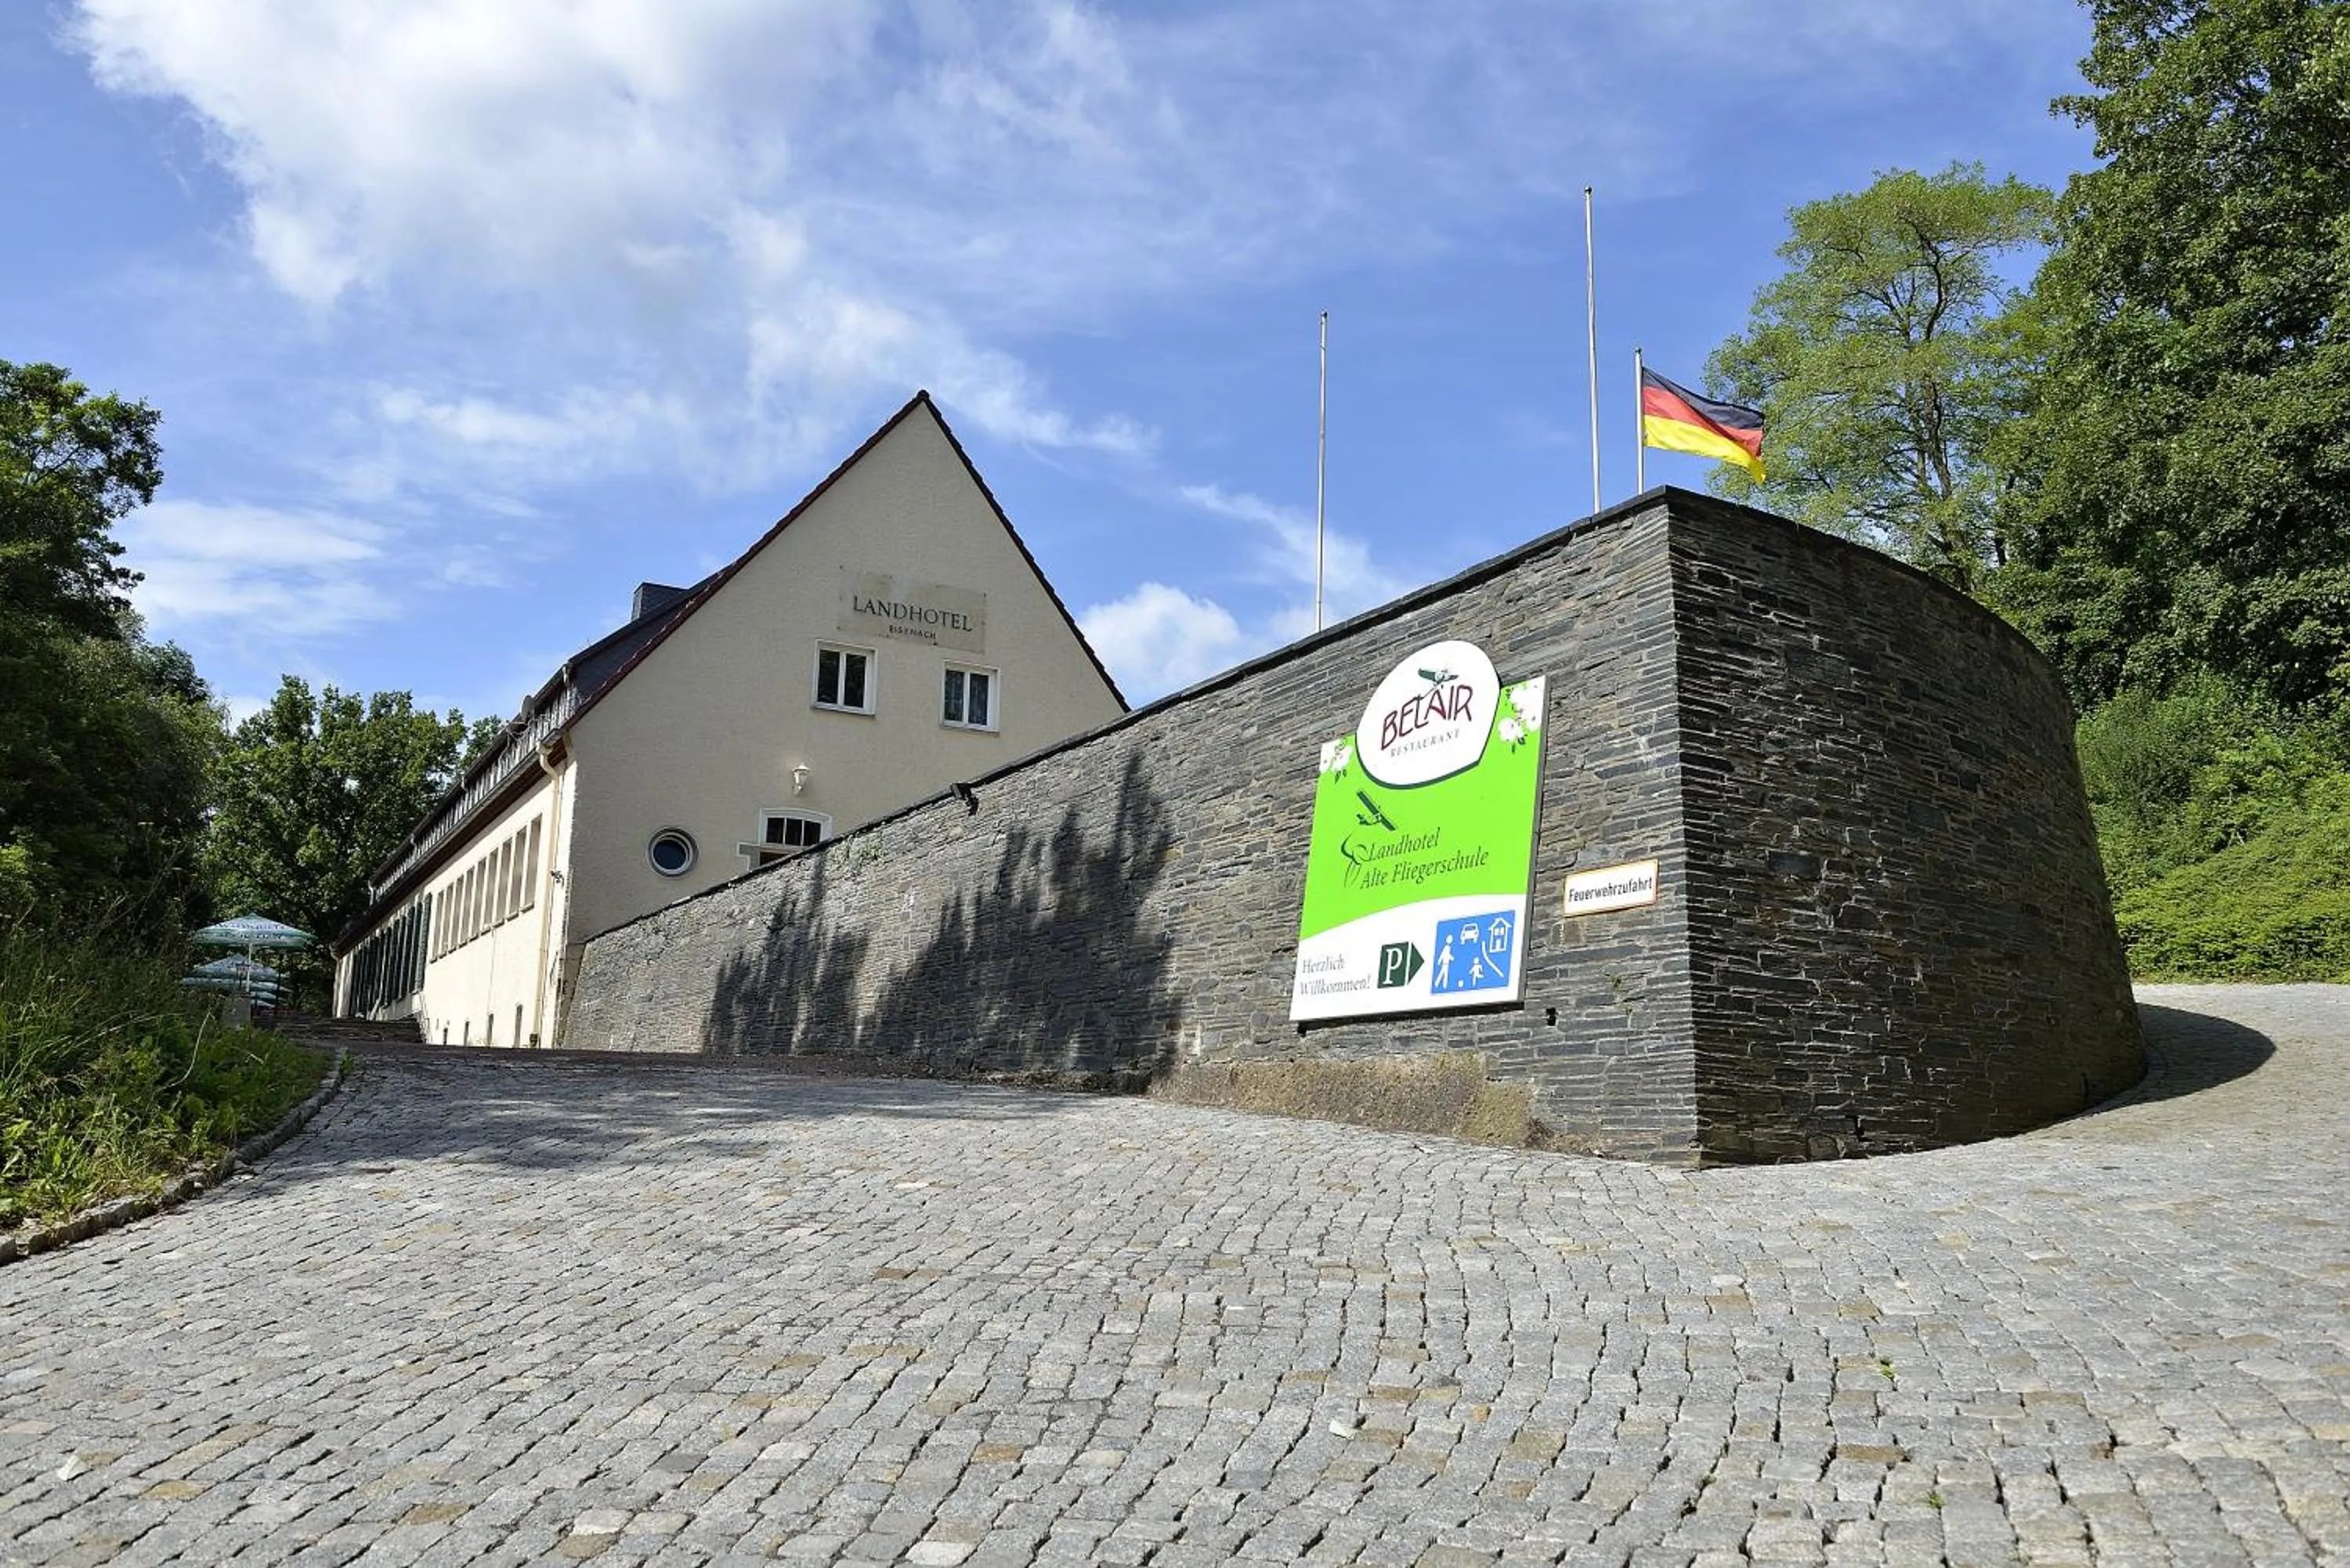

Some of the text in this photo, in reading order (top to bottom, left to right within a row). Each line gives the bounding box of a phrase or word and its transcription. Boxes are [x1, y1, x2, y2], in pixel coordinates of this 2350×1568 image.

[852, 594, 973, 632] LANDHOTEL
[889, 625, 937, 640] EISENACH
[1390, 728, 1461, 758] RESTAURANT
[1368, 826, 1441, 862] Landhotel
[1359, 846, 1489, 890] Alte Fliegerschule
[1568, 876, 1653, 903] Feuerwehrzufahrt
[1303, 954, 1345, 974] Herzlich
[1384, 948, 1404, 985] P
[1300, 974, 1371, 995] Willkommen!
